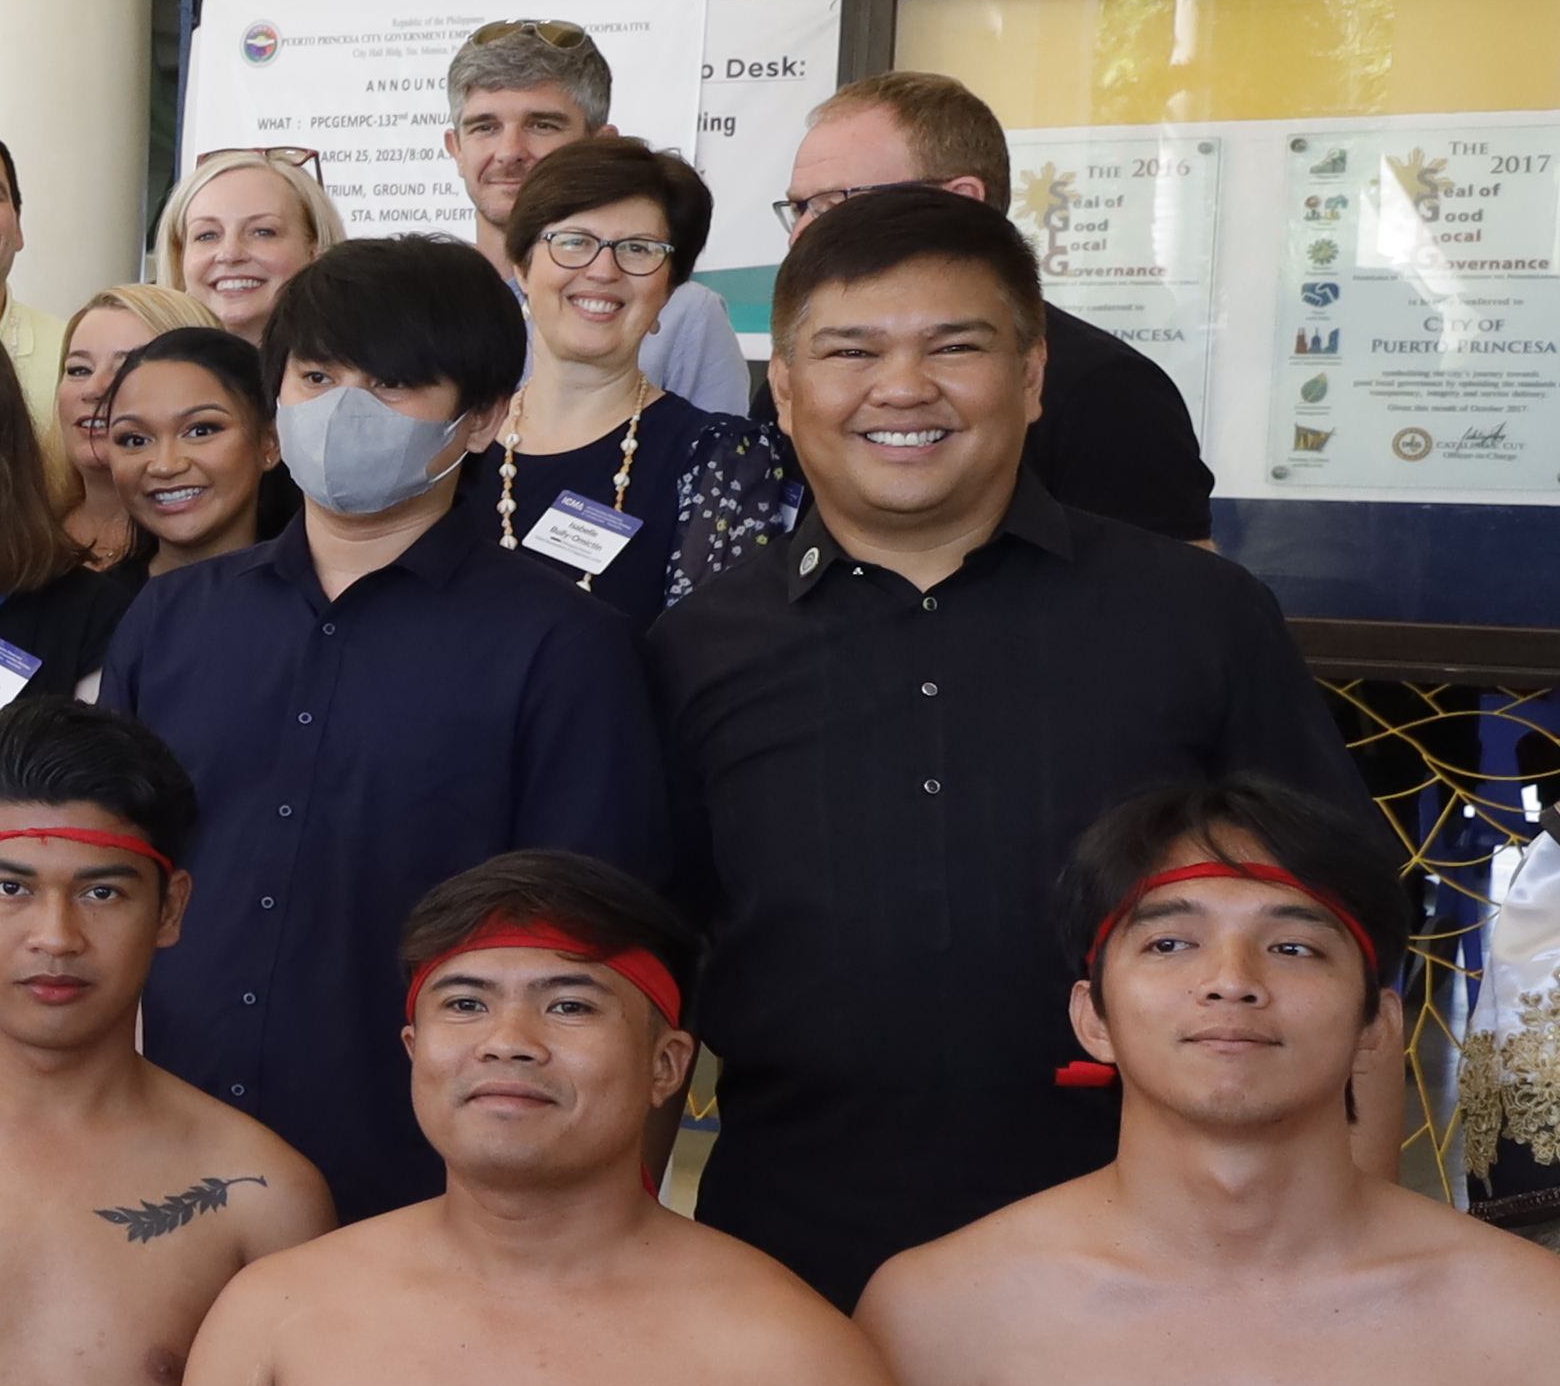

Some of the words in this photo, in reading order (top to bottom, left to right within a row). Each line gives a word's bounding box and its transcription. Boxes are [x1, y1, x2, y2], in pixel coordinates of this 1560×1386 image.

[726, 56, 806, 79] Desk:
[366, 77, 446, 92] ANNOUNC
[258, 117, 291, 130] WHAT
[320, 150, 352, 163] ARCH
[354, 150, 371, 164] 25,
[376, 147, 434, 162] 2023/8:00
[1448, 141, 1489, 156] THE
[1088, 164, 1122, 179] THE
[1490, 154, 1551, 174] 2017
[373, 182, 425, 197] GROUND
[1478, 183, 1501, 198] of
[1104, 194, 1125, 209] of
[351, 209, 375, 222] STA.
[379, 208, 431, 223] MONICA,
[435, 207, 476, 221] PUERT
[1478, 318, 1506, 333] OF
[1113, 328, 1185, 342] INCESA
[1457, 339, 1558, 355] PRINCESA
[561, 496, 585, 512] ICMA
